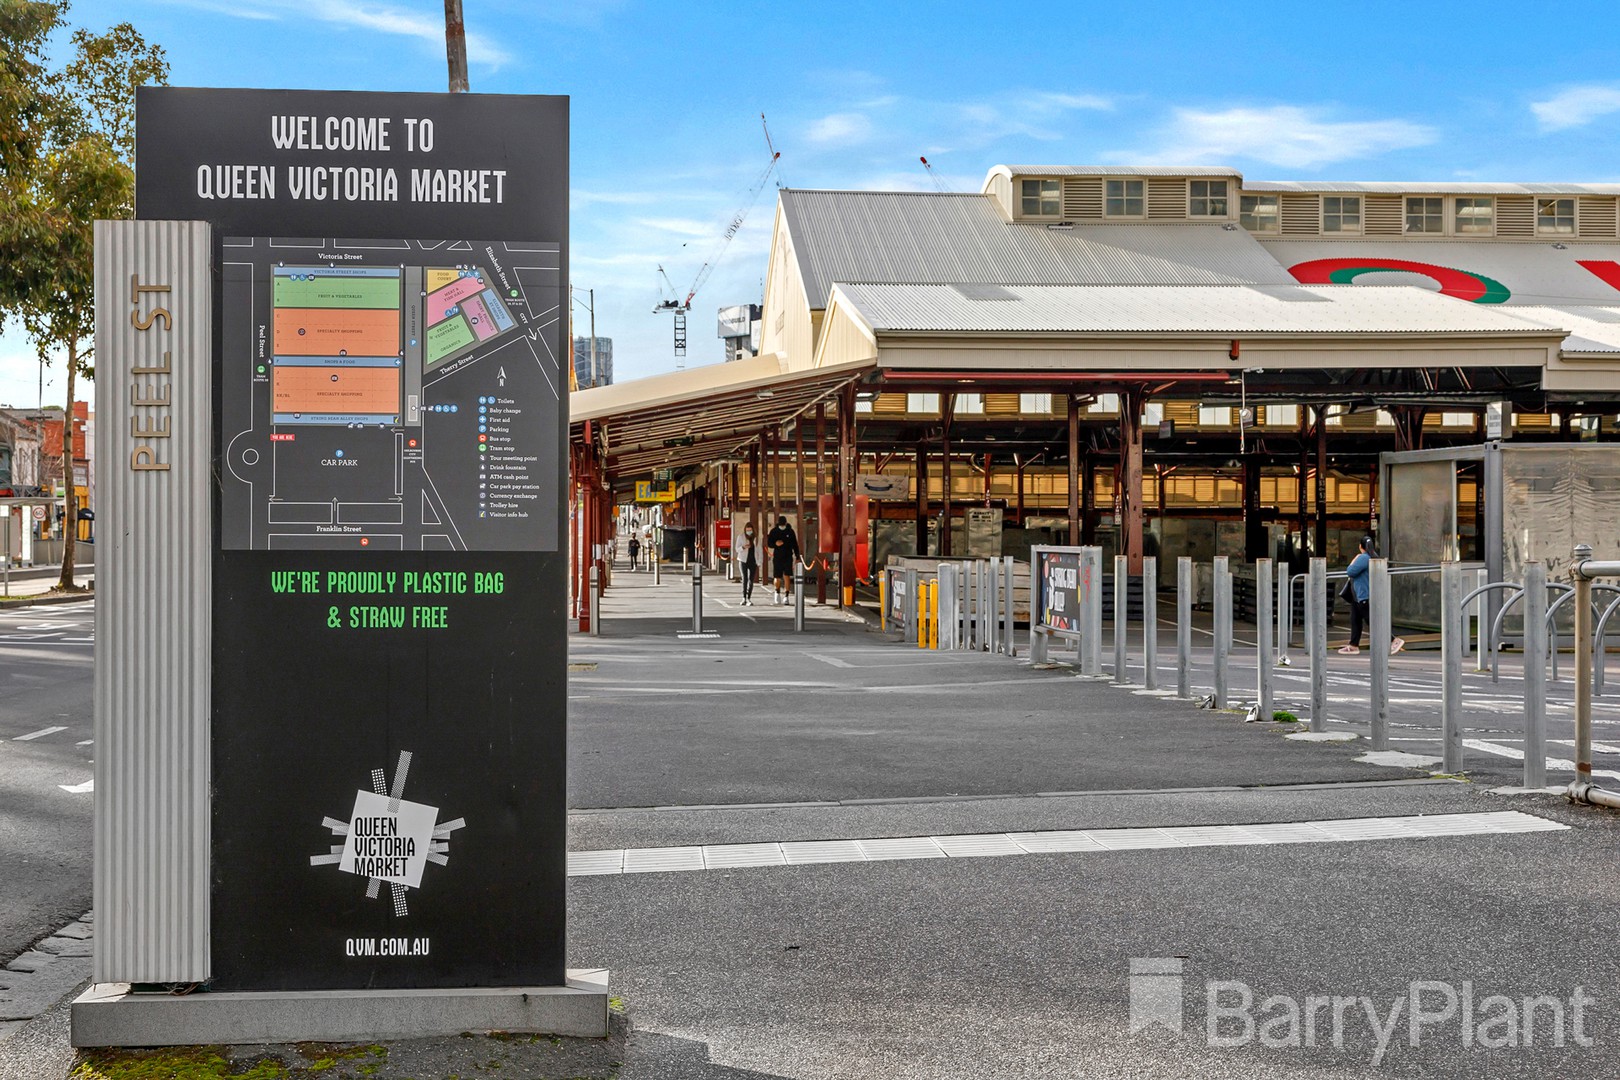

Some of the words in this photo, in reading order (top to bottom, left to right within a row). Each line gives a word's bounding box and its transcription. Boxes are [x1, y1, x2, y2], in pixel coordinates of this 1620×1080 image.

[271, 115, 391, 151] WELCOME
[404, 118, 434, 152] TO
[197, 165, 275, 200] QUEEN
[288, 166, 399, 201] VICTORIA
[411, 168, 507, 203] MARKET
[486, 246, 502, 273] Elizabeth
[499, 271, 511, 290] Street
[131, 274, 172, 331] ST
[520, 312, 528, 324] CITY
[435, 325, 459, 338] VEGETABLES
[440, 340, 461, 352] ORGANICS
[440, 361, 459, 374] Therry
[458, 355, 474, 366] Street
[131, 351, 171, 471] PEEL
[272, 571, 320, 593] WE'RE
[327, 572, 396, 593] PROUDLY
[403, 572, 467, 594] PLASTIC
[474, 572, 504, 594] BAG
[327, 606, 342, 628] &
[350, 606, 405, 628] STRAW
[412, 606, 448, 628] FREE
[354, 817, 397, 837] QUEEN
[354, 837, 415, 856] VICTORIA
[354, 858, 408, 877] MARKET
[346, 938, 430, 956] QVM.COM.AU
